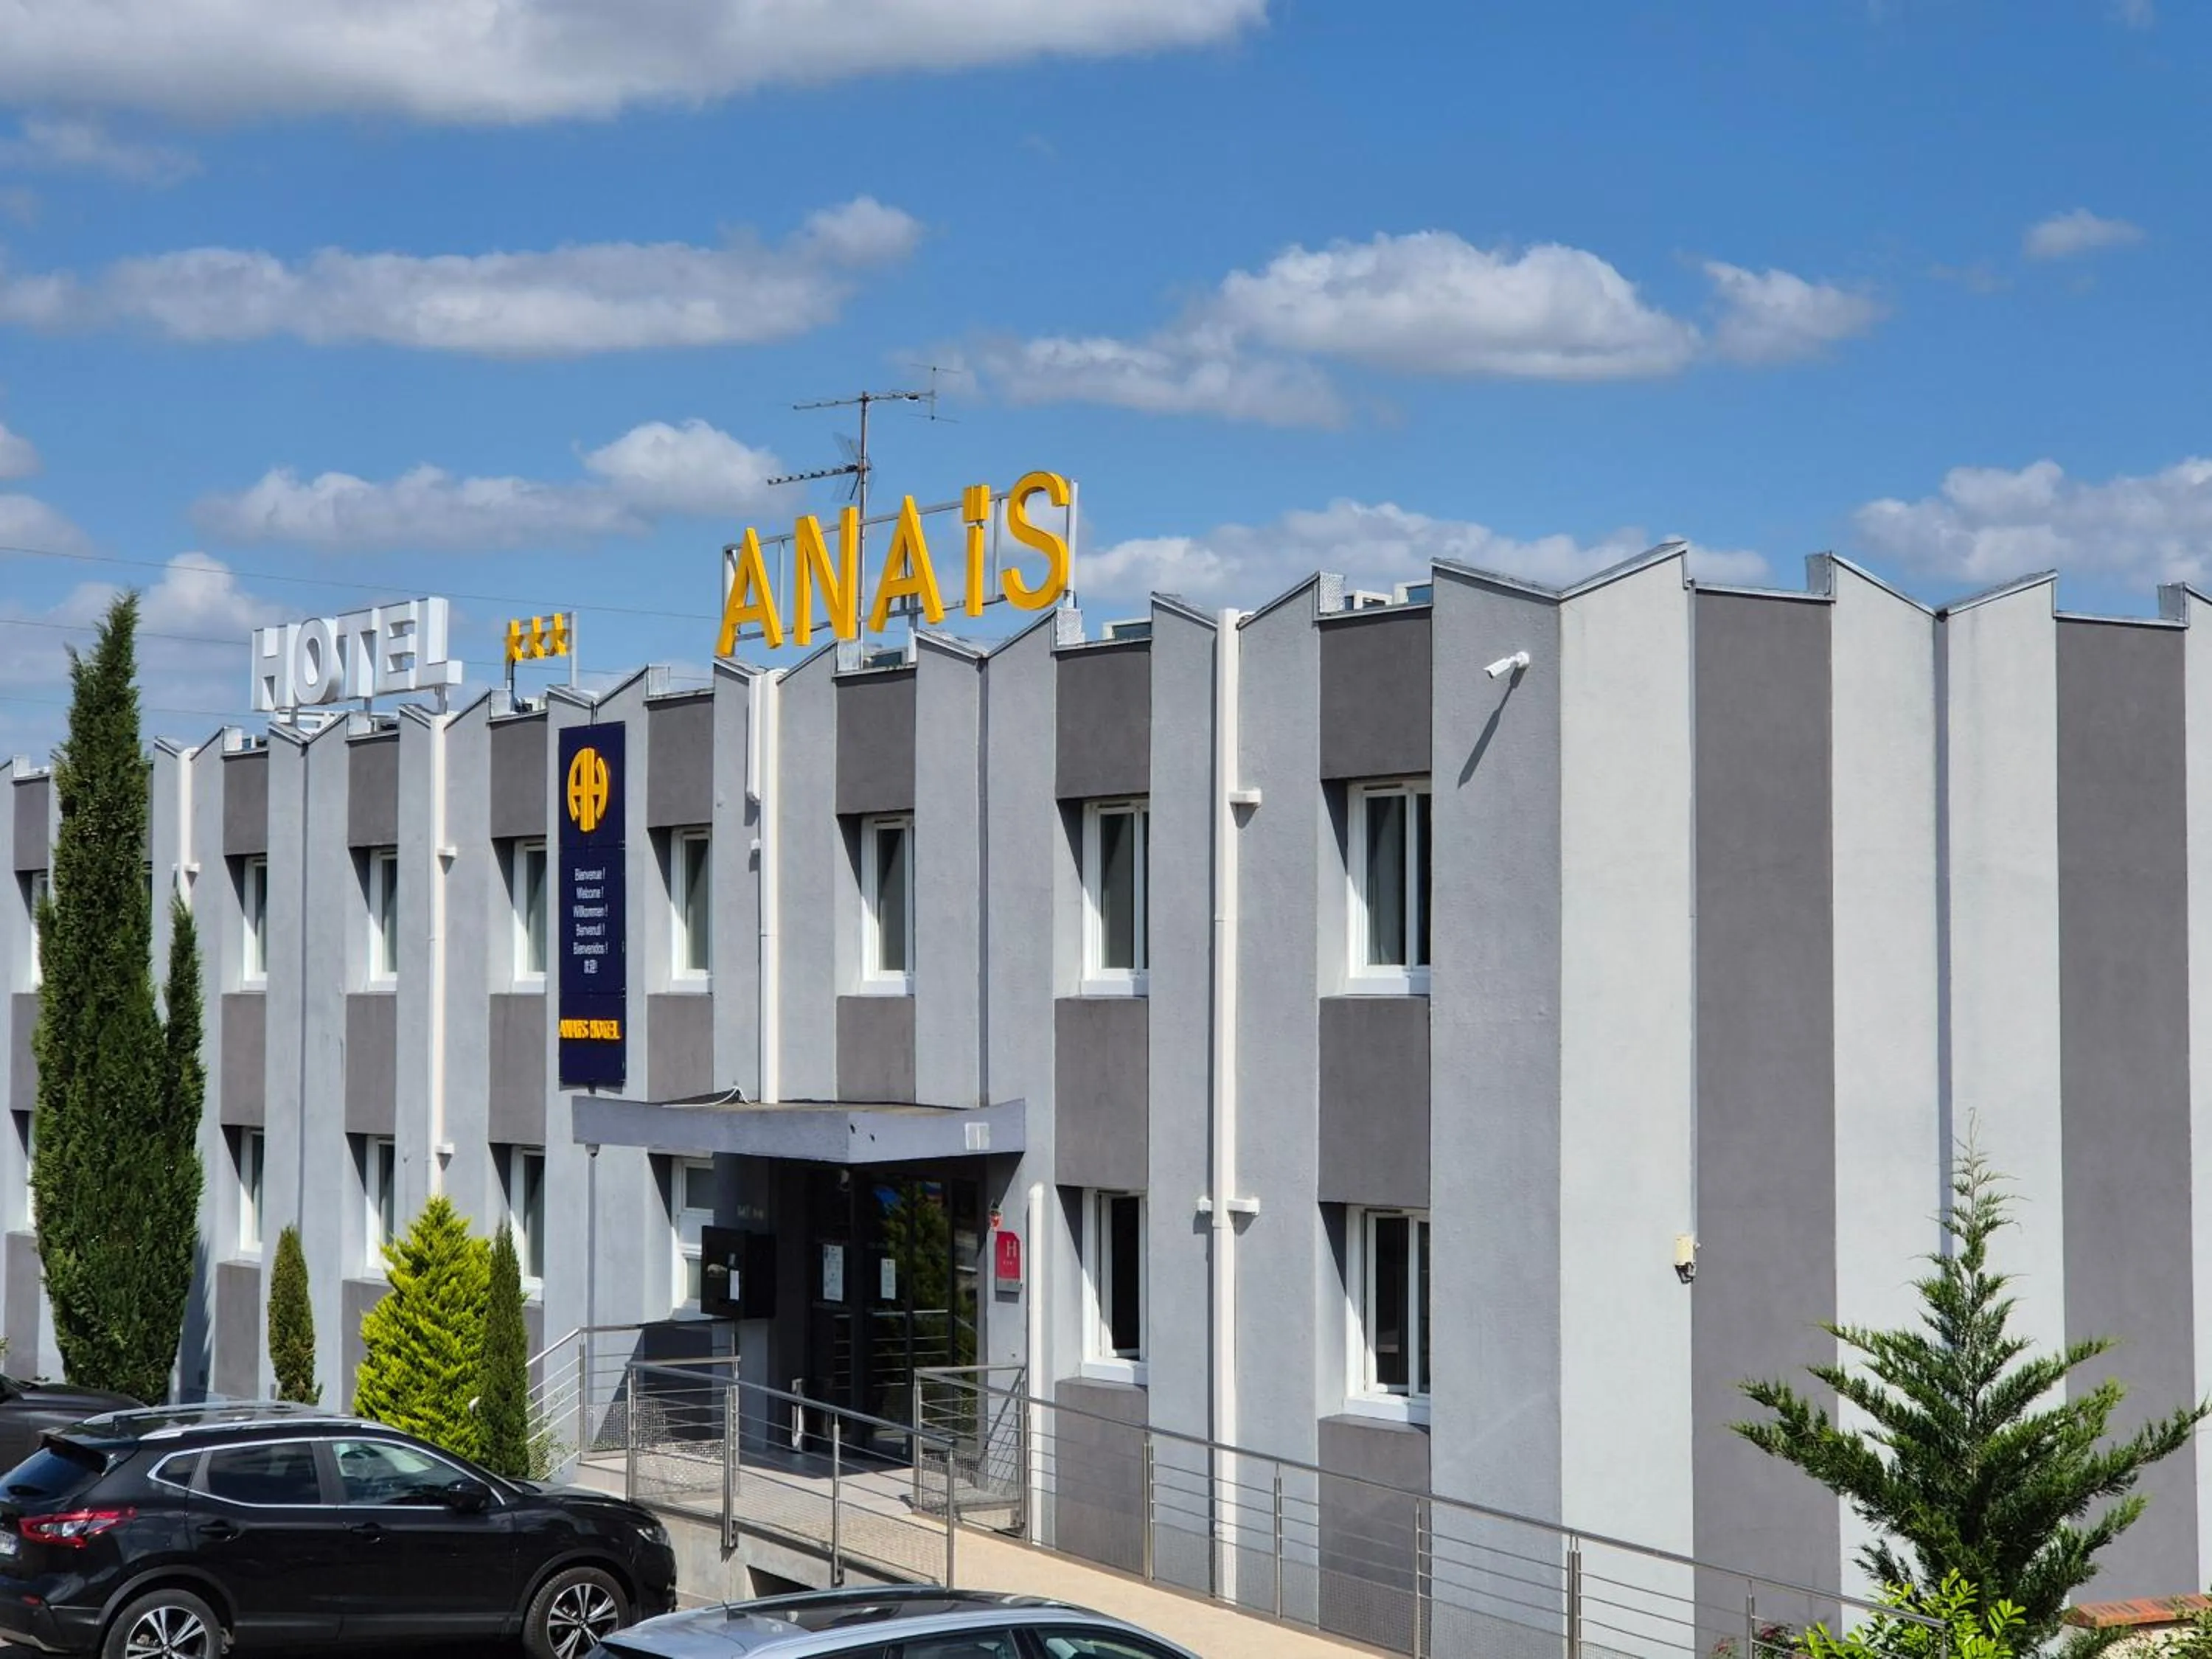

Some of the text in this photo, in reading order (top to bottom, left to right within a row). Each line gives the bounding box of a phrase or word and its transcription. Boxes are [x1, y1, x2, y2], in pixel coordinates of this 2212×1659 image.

[714, 470, 1070, 657] ANAÏS
[251, 597, 463, 712] HOTEL
[1006, 1240, 1018, 1258] H
